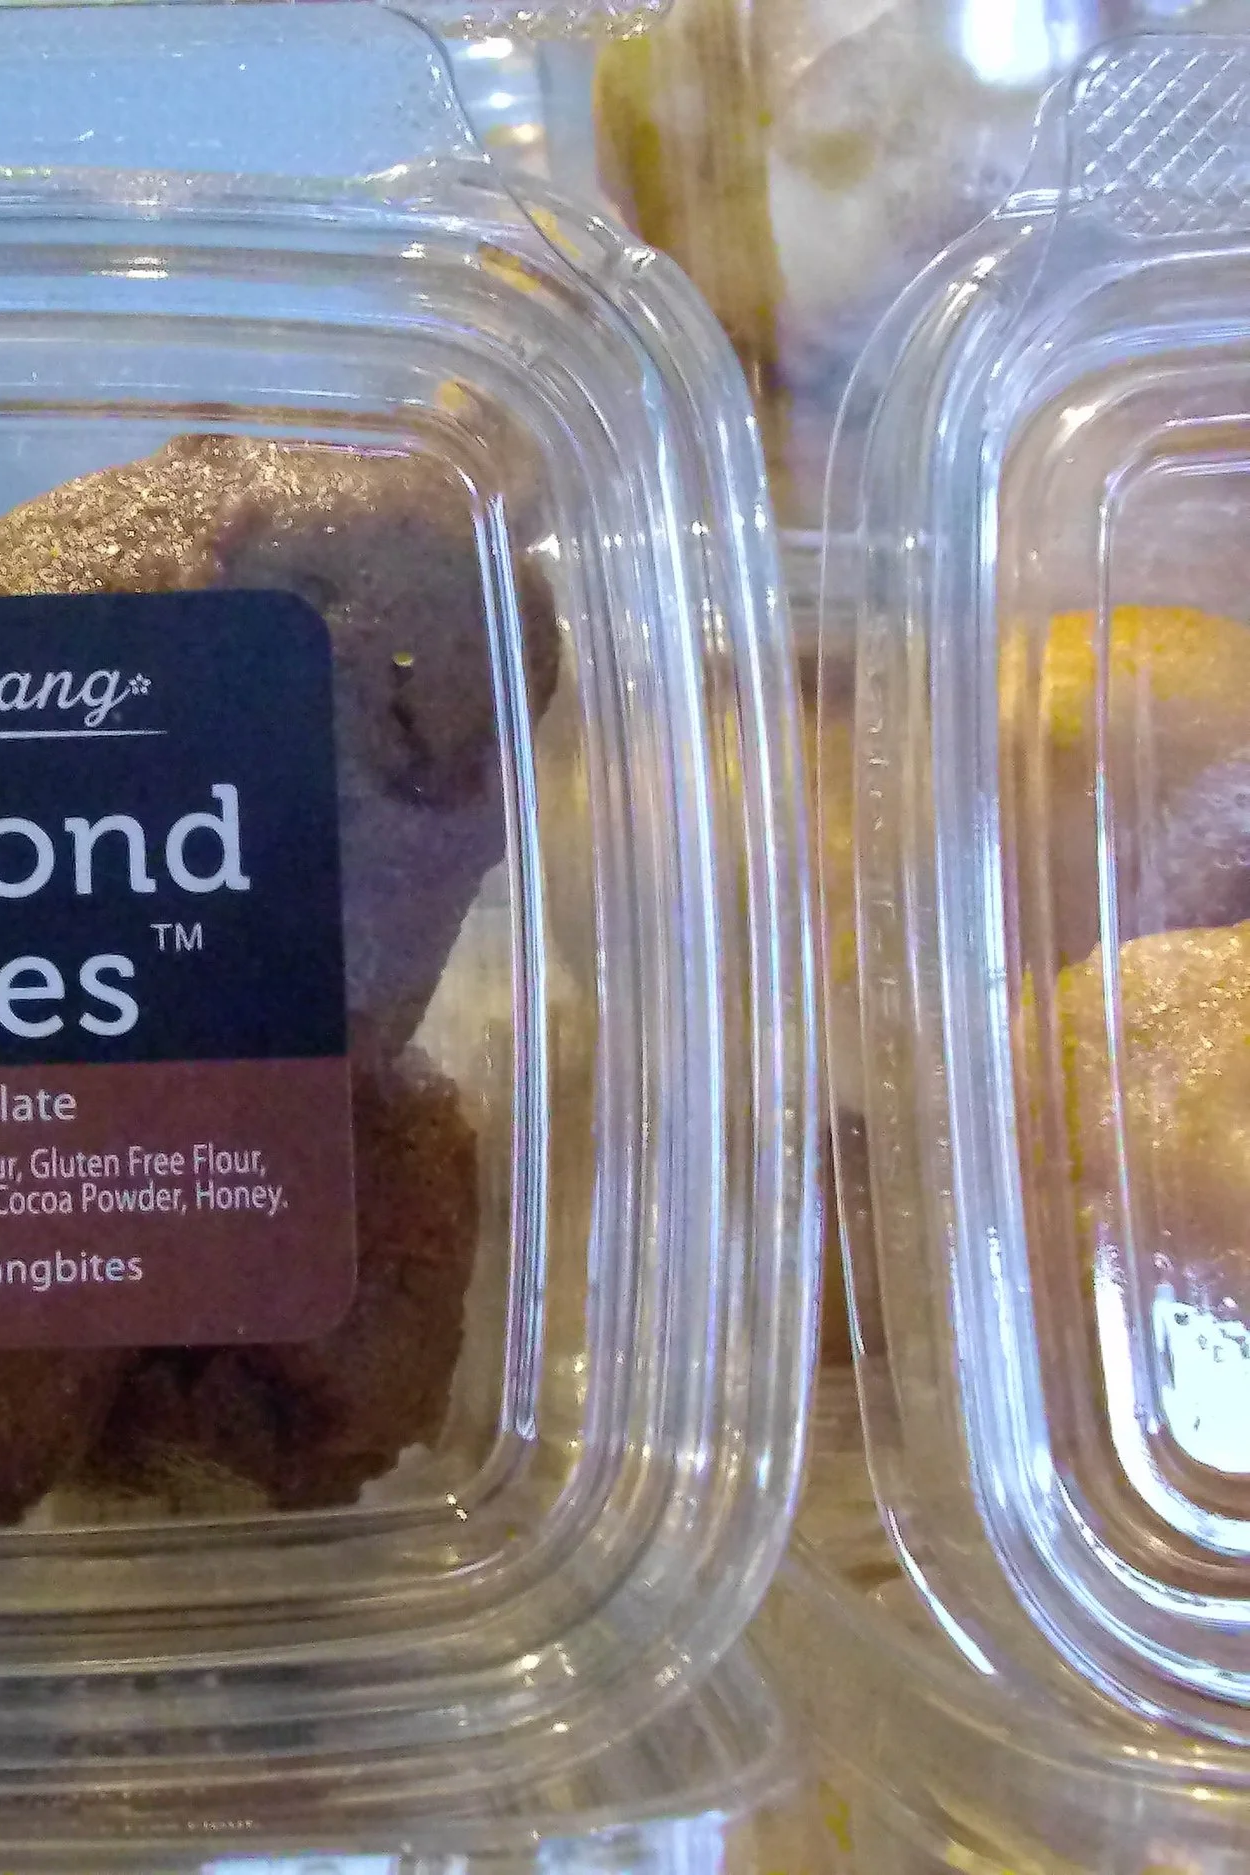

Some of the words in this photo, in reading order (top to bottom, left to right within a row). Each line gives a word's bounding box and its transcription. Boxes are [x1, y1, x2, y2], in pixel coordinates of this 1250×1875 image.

[151, 922, 204, 951] TM
[30, 1146, 121, 1181] Gluten
[128, 1144, 186, 1178] Free
[192, 1140, 267, 1178] Flour,
[80, 1179, 189, 1216] Powder,
[194, 1178, 290, 1218] Honey.
